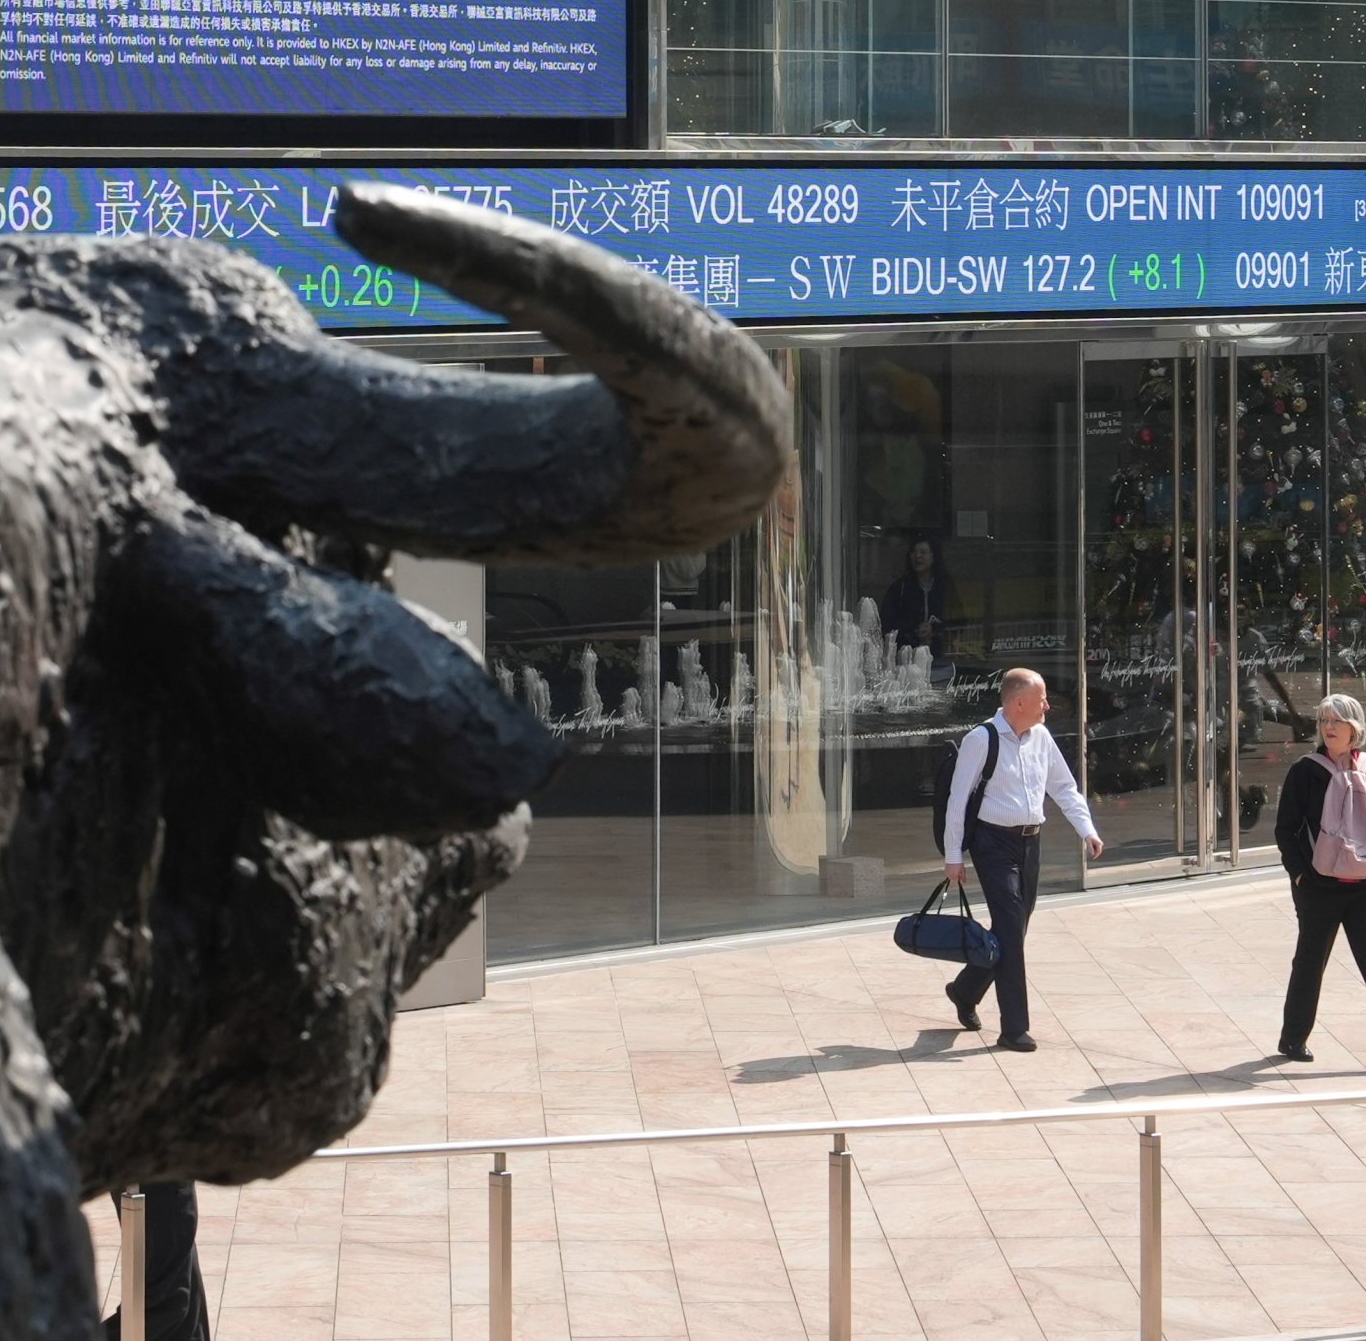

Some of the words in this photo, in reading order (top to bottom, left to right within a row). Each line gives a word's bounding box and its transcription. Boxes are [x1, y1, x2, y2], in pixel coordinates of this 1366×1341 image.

[0, 31, 13, 42] All
[17, 31, 58, 43] financial
[61, 32, 96, 44] market
[99, 33, 155, 45] information
[159, 35, 166, 45] is
[169, 34, 182, 46] for
[186, 35, 230, 47] reference
[232, 36, 254, 50] only.
[257, 37, 264, 47] It
[267, 37, 274, 48] is
[277, 37, 316, 50] provided
[319, 39, 329, 49] to
[332, 38, 359, 49] HKEX
[362, 38, 373, 52] by
[376, 39, 416, 50] N2N-AFE
[419, 40, 446, 54] (Hong
[450, 40, 475, 54] Kong)
[478, 41, 510, 52] Limited
[513, 42, 529, 52] and
[532, 42, 568, 53] Refinitiv.
[570, 43, 597, 55] HKEX,
[96, 179, 280, 240] 最後成交
[550, 178, 671, 235] 成交額
[686, 185, 754, 224] VOL
[768, 184, 858, 223] 48289
[891, 178, 1069, 231] 未平倉合約
[1086, 184, 1167, 221] OPEN
[1178, 185, 1222, 220] INT
[1237, 184, 1322, 220] 109091
[873, 256, 1007, 294] BIDU-SW
[1023, 254, 1095, 292] 127.2
[1236, 252, 1308, 288] 09901
